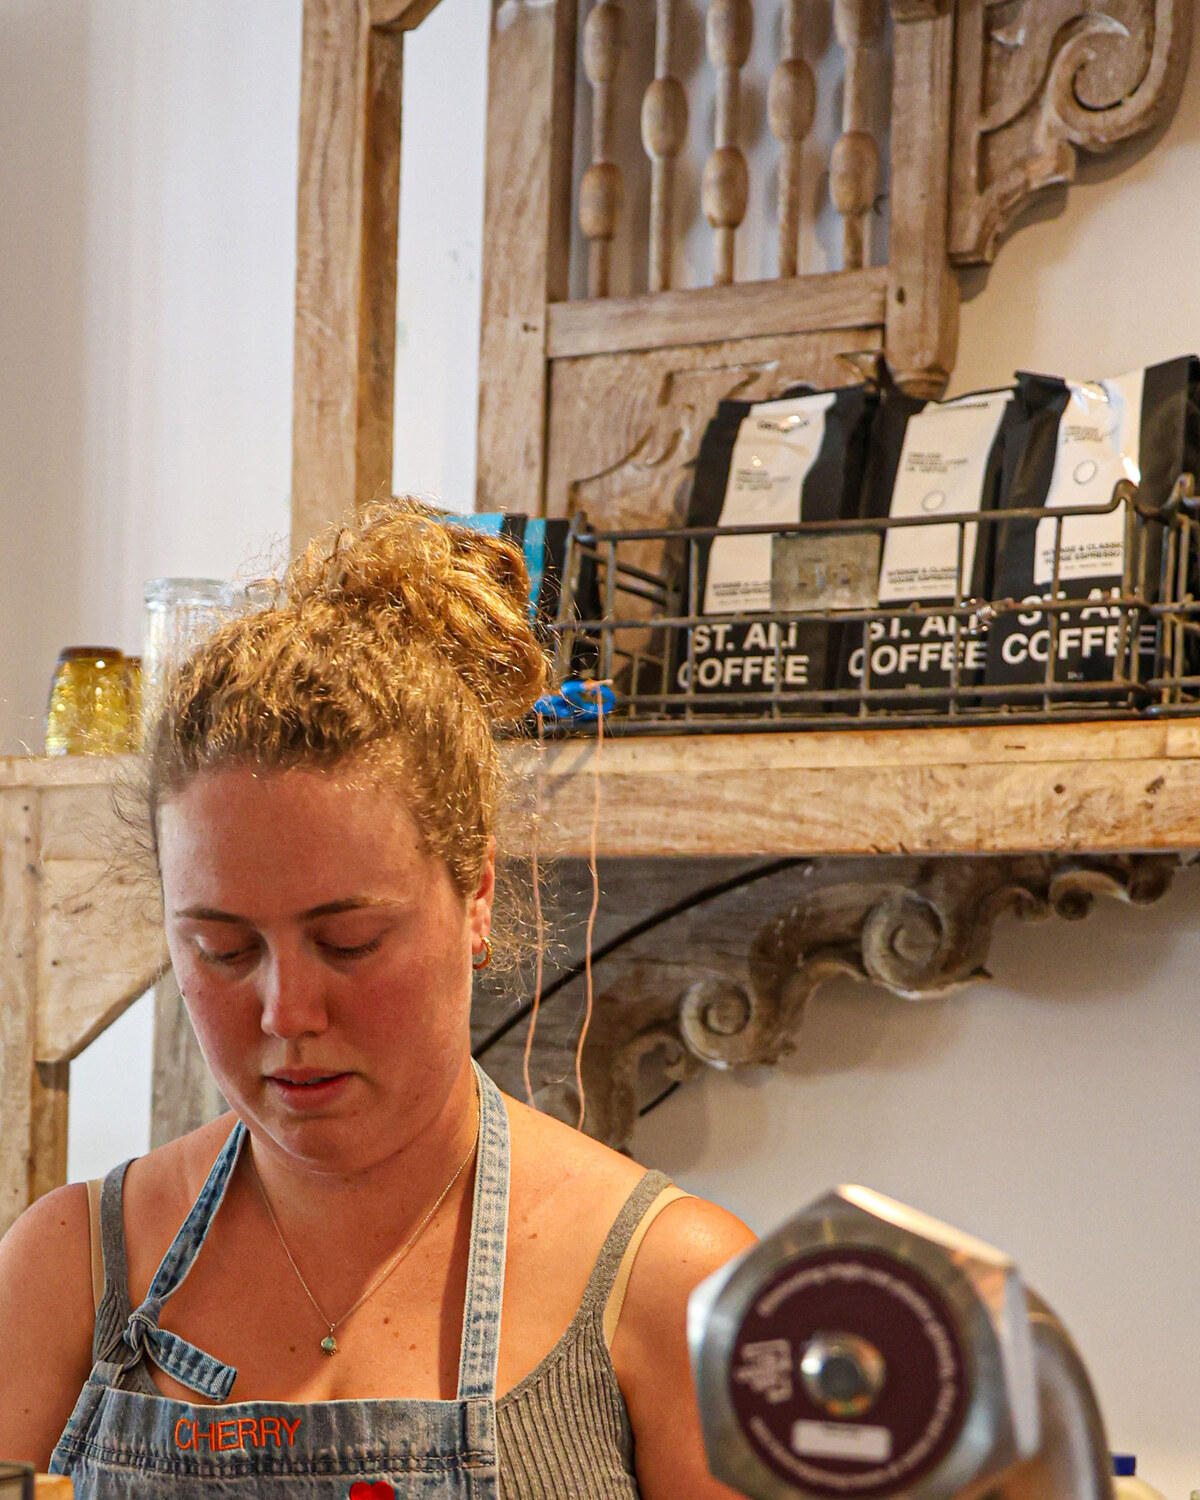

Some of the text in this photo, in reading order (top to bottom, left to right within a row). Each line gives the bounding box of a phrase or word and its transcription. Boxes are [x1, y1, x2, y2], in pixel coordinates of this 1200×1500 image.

[693, 624, 734, 654] ST.
[677, 655, 809, 688] COFFEE
[848, 640, 987, 679] COFFEE
[174, 1416, 302, 1451] CHERRY
